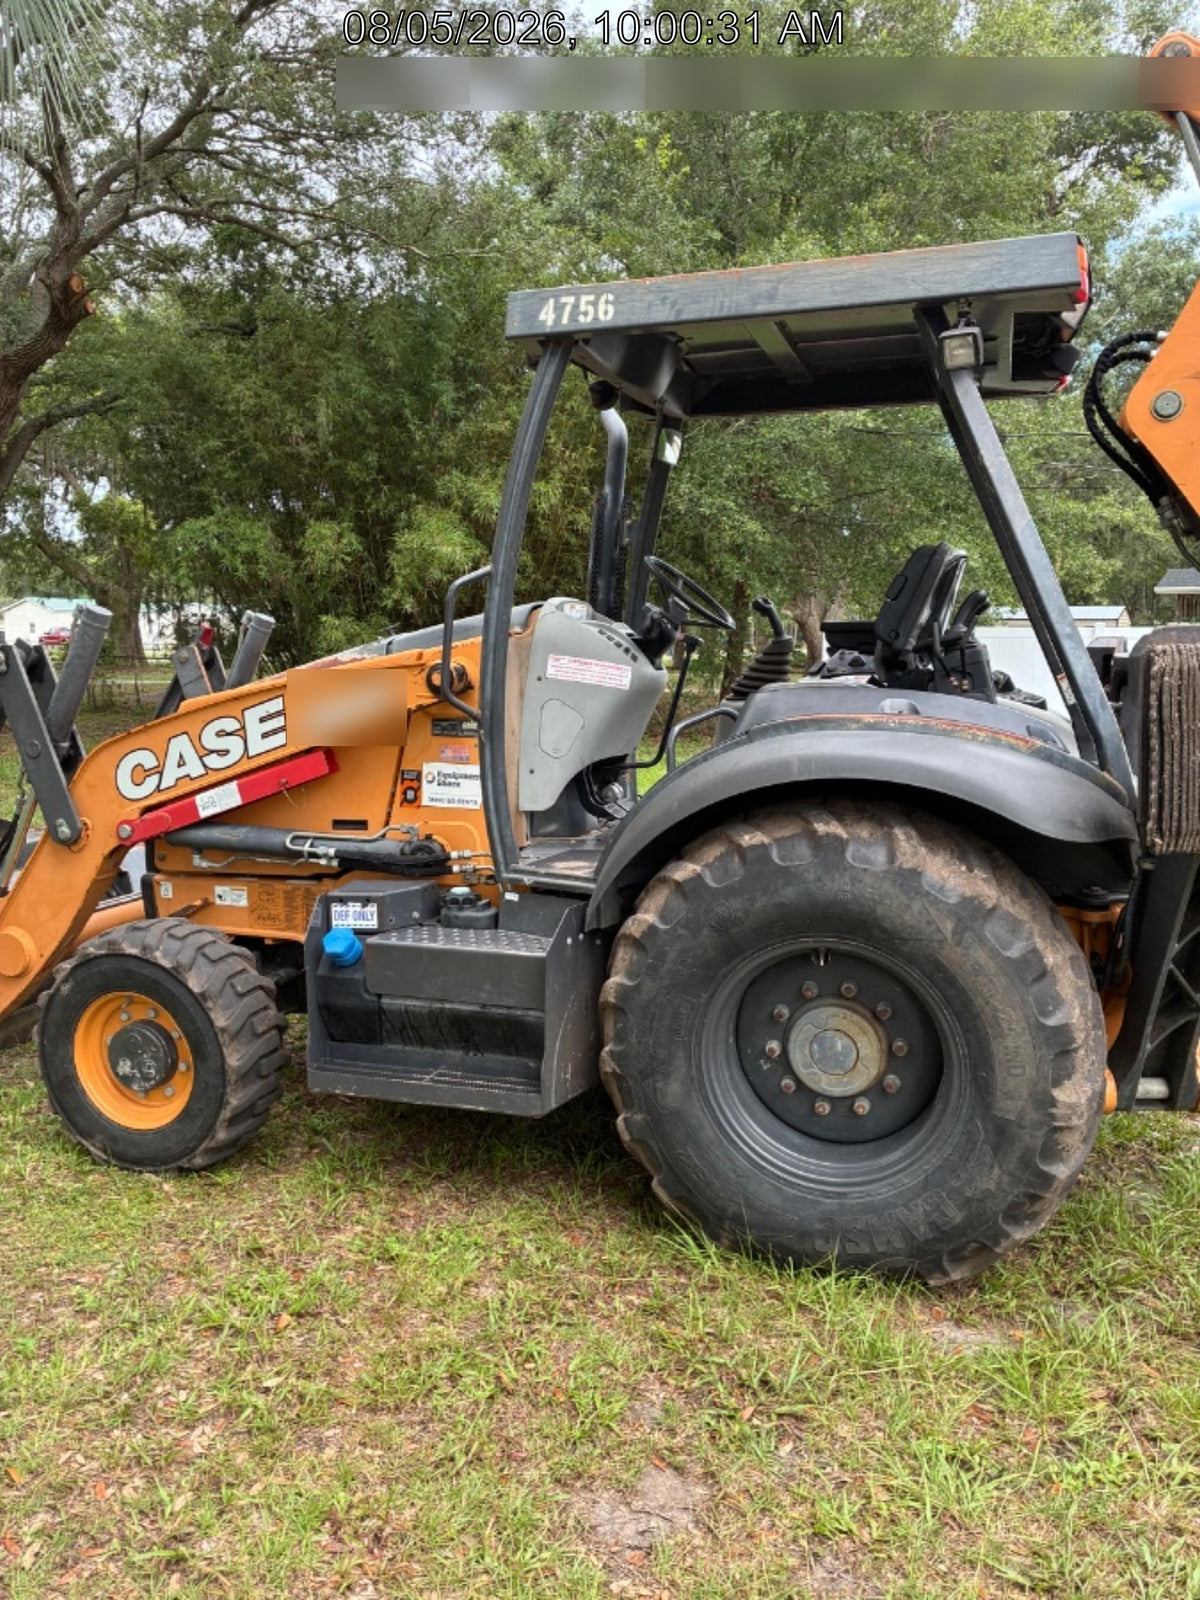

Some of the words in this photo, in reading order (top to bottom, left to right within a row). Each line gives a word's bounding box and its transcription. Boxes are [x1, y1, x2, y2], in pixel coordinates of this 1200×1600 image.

[538, 292, 615, 328] 4756
[115, 694, 288, 801] CASE
[333, 910, 350, 921] DEF
[352, 910, 376, 922] ONLY
